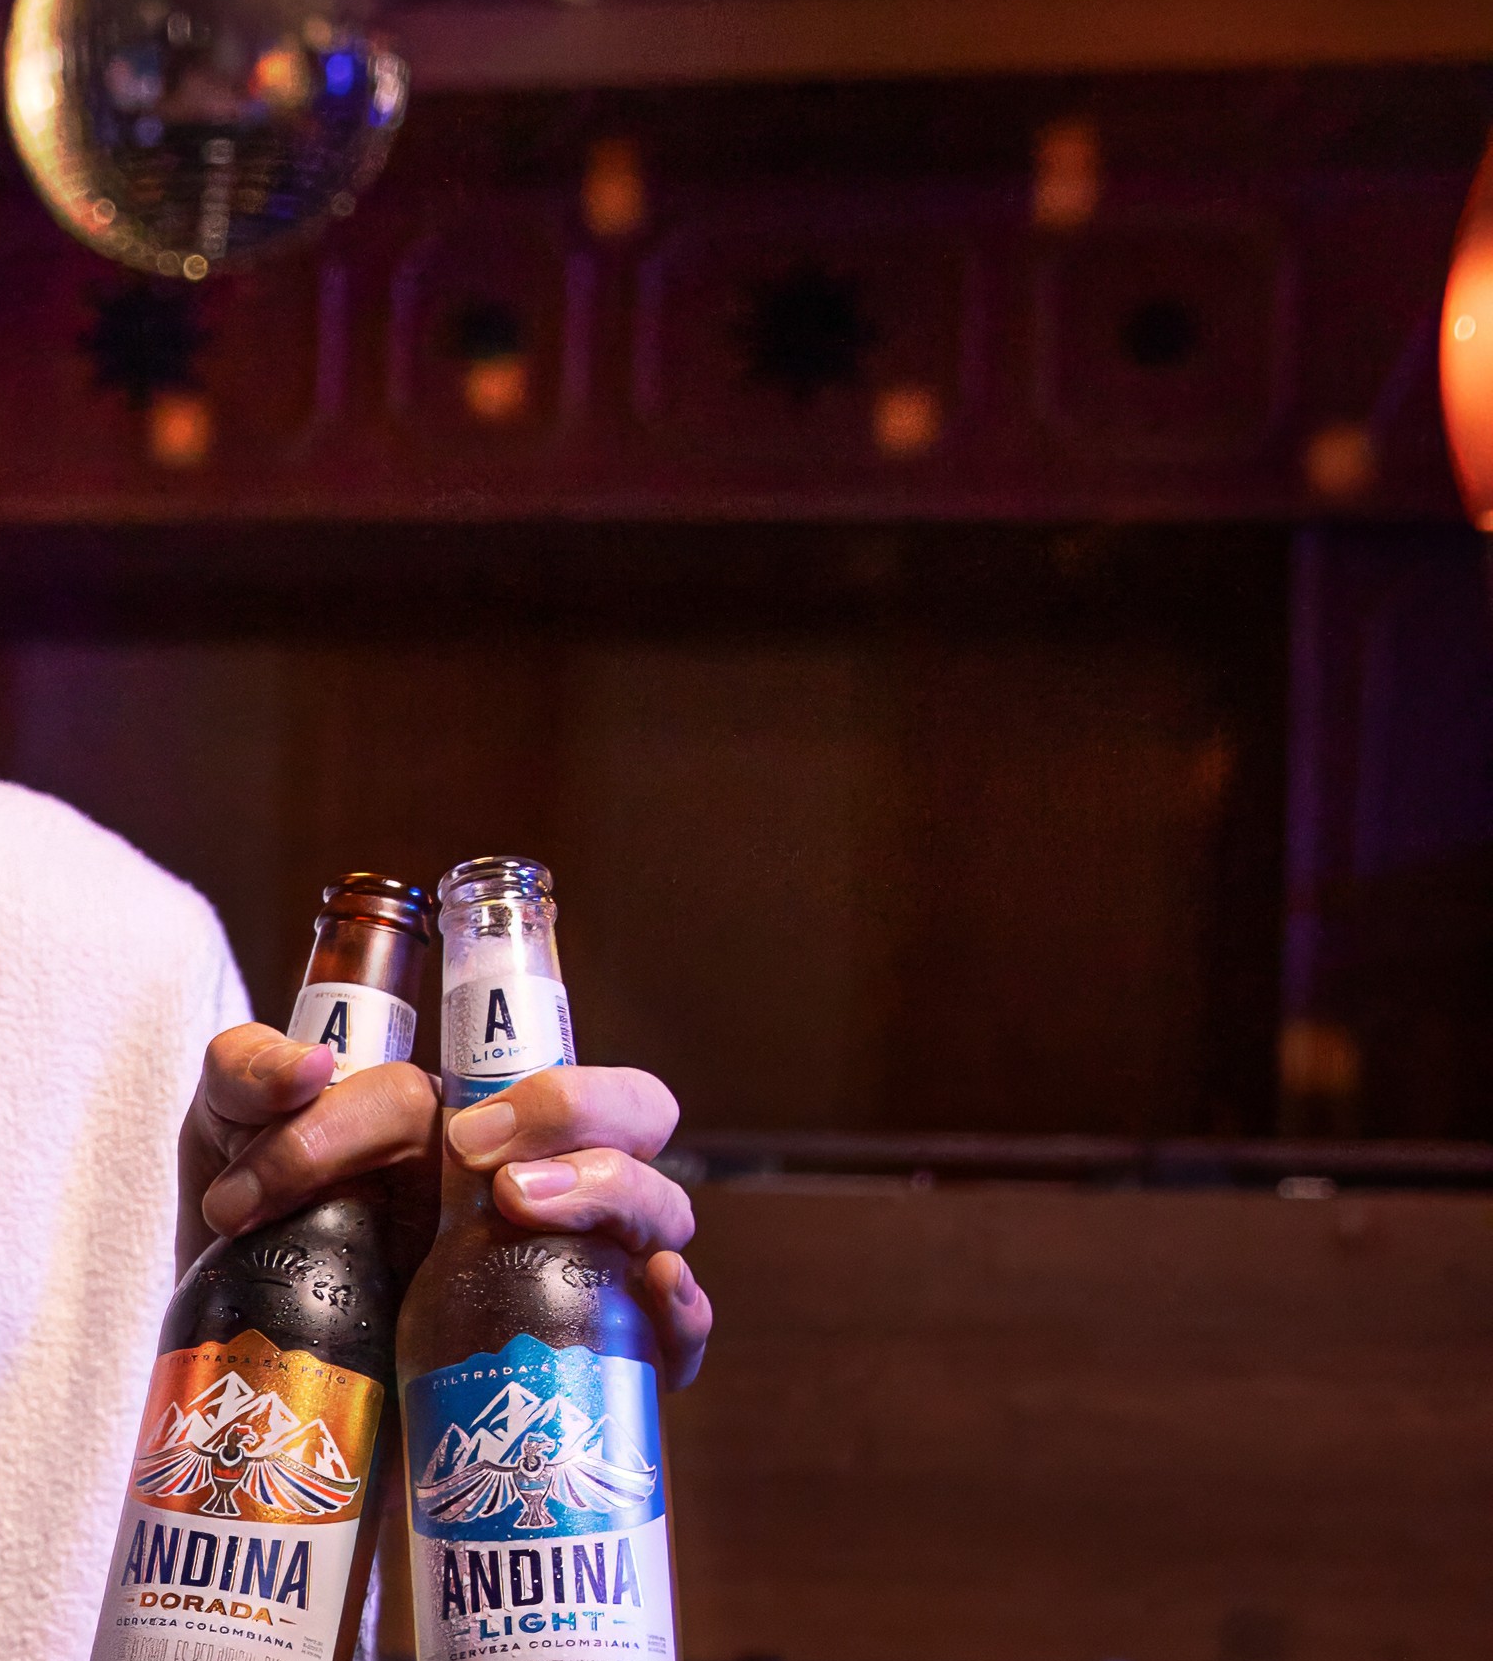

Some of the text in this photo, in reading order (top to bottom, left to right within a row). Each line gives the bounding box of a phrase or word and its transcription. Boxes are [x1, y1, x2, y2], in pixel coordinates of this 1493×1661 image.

[319, 1000, 350, 1054] A
[485, 988, 516, 1044] A
[472, 1046, 527, 1064] LIGH
[170, 1354, 251, 1364] ILTRADA
[121, 1520, 312, 1611] ANDINA
[442, 1538, 643, 1620] ANDINA
[139, 1591, 273, 1626] DORADA
[185, 1621, 294, 1650] COLOMBIANA
[479, 1612, 605, 1640] LIGHT
[449, 1643, 521, 1661] CERVEZA
